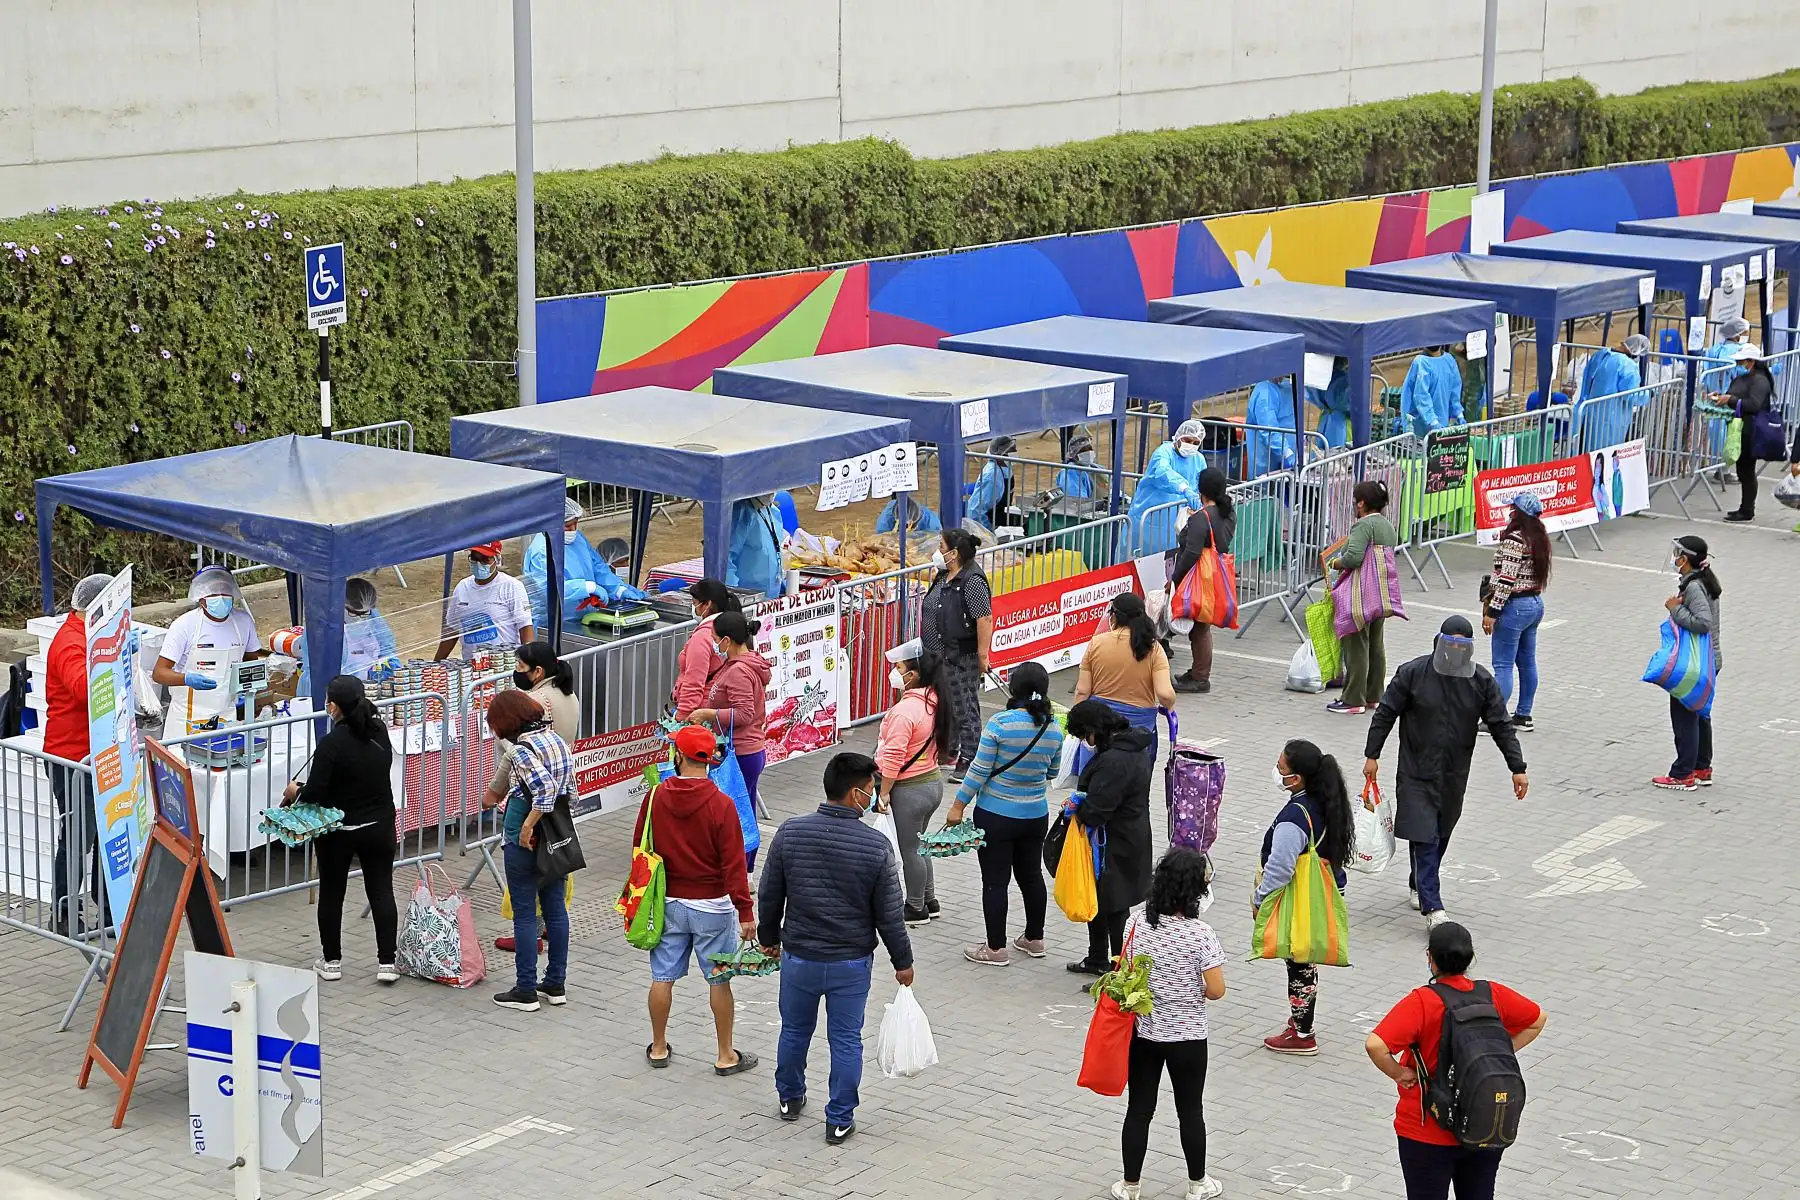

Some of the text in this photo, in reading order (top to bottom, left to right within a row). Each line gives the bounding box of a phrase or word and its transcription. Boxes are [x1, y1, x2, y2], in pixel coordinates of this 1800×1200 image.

[311, 307, 343, 318] ESTACIONAMIENTO
[1092, 384, 1111, 397] POLLO
[963, 403, 987, 419] POLLO
[1481, 465, 1576, 489] NO ME AMONTONO EN LOS PUESTOS
[1558, 482, 1565, 492] DE
[1549, 495, 1577, 510] PERSONAS
[756, 586, 835, 617] CARNE DE CERDO
[995, 581, 1131, 628] AL LLEGAR A CASA, ME LAVO LAS MANOS
[775, 617, 782, 627] AL
[782, 615, 794, 626] POR
[794, 609, 811, 622] MAYOR
[816, 604, 835, 617] MENOR
[995, 632, 1012, 648] CON
[1014, 629, 1031, 643] AGUA
[1032, 627, 1037, 637] Y
[1038, 616, 1061, 636] JABÓN
[1064, 614, 1078, 628] POR
[1079, 611, 1088, 624] 20
[795, 666, 811, 679] CHULETA
[580, 732, 629, 750] AMONTONO
[631, 728, 642, 740] EN
[574, 751, 604, 768] NTENGO
[606, 749, 617, 759] MI
[619, 739, 661, 755] DISTANCIA
[584, 766, 609, 784] METRO
[610, 762, 626, 774] CON
[628, 753, 653, 769] OTRAS
[270, 1090, 283, 1099] film
[1495, 1092, 1508, 1103] CAT
[189, 1114, 206, 1155] anel
